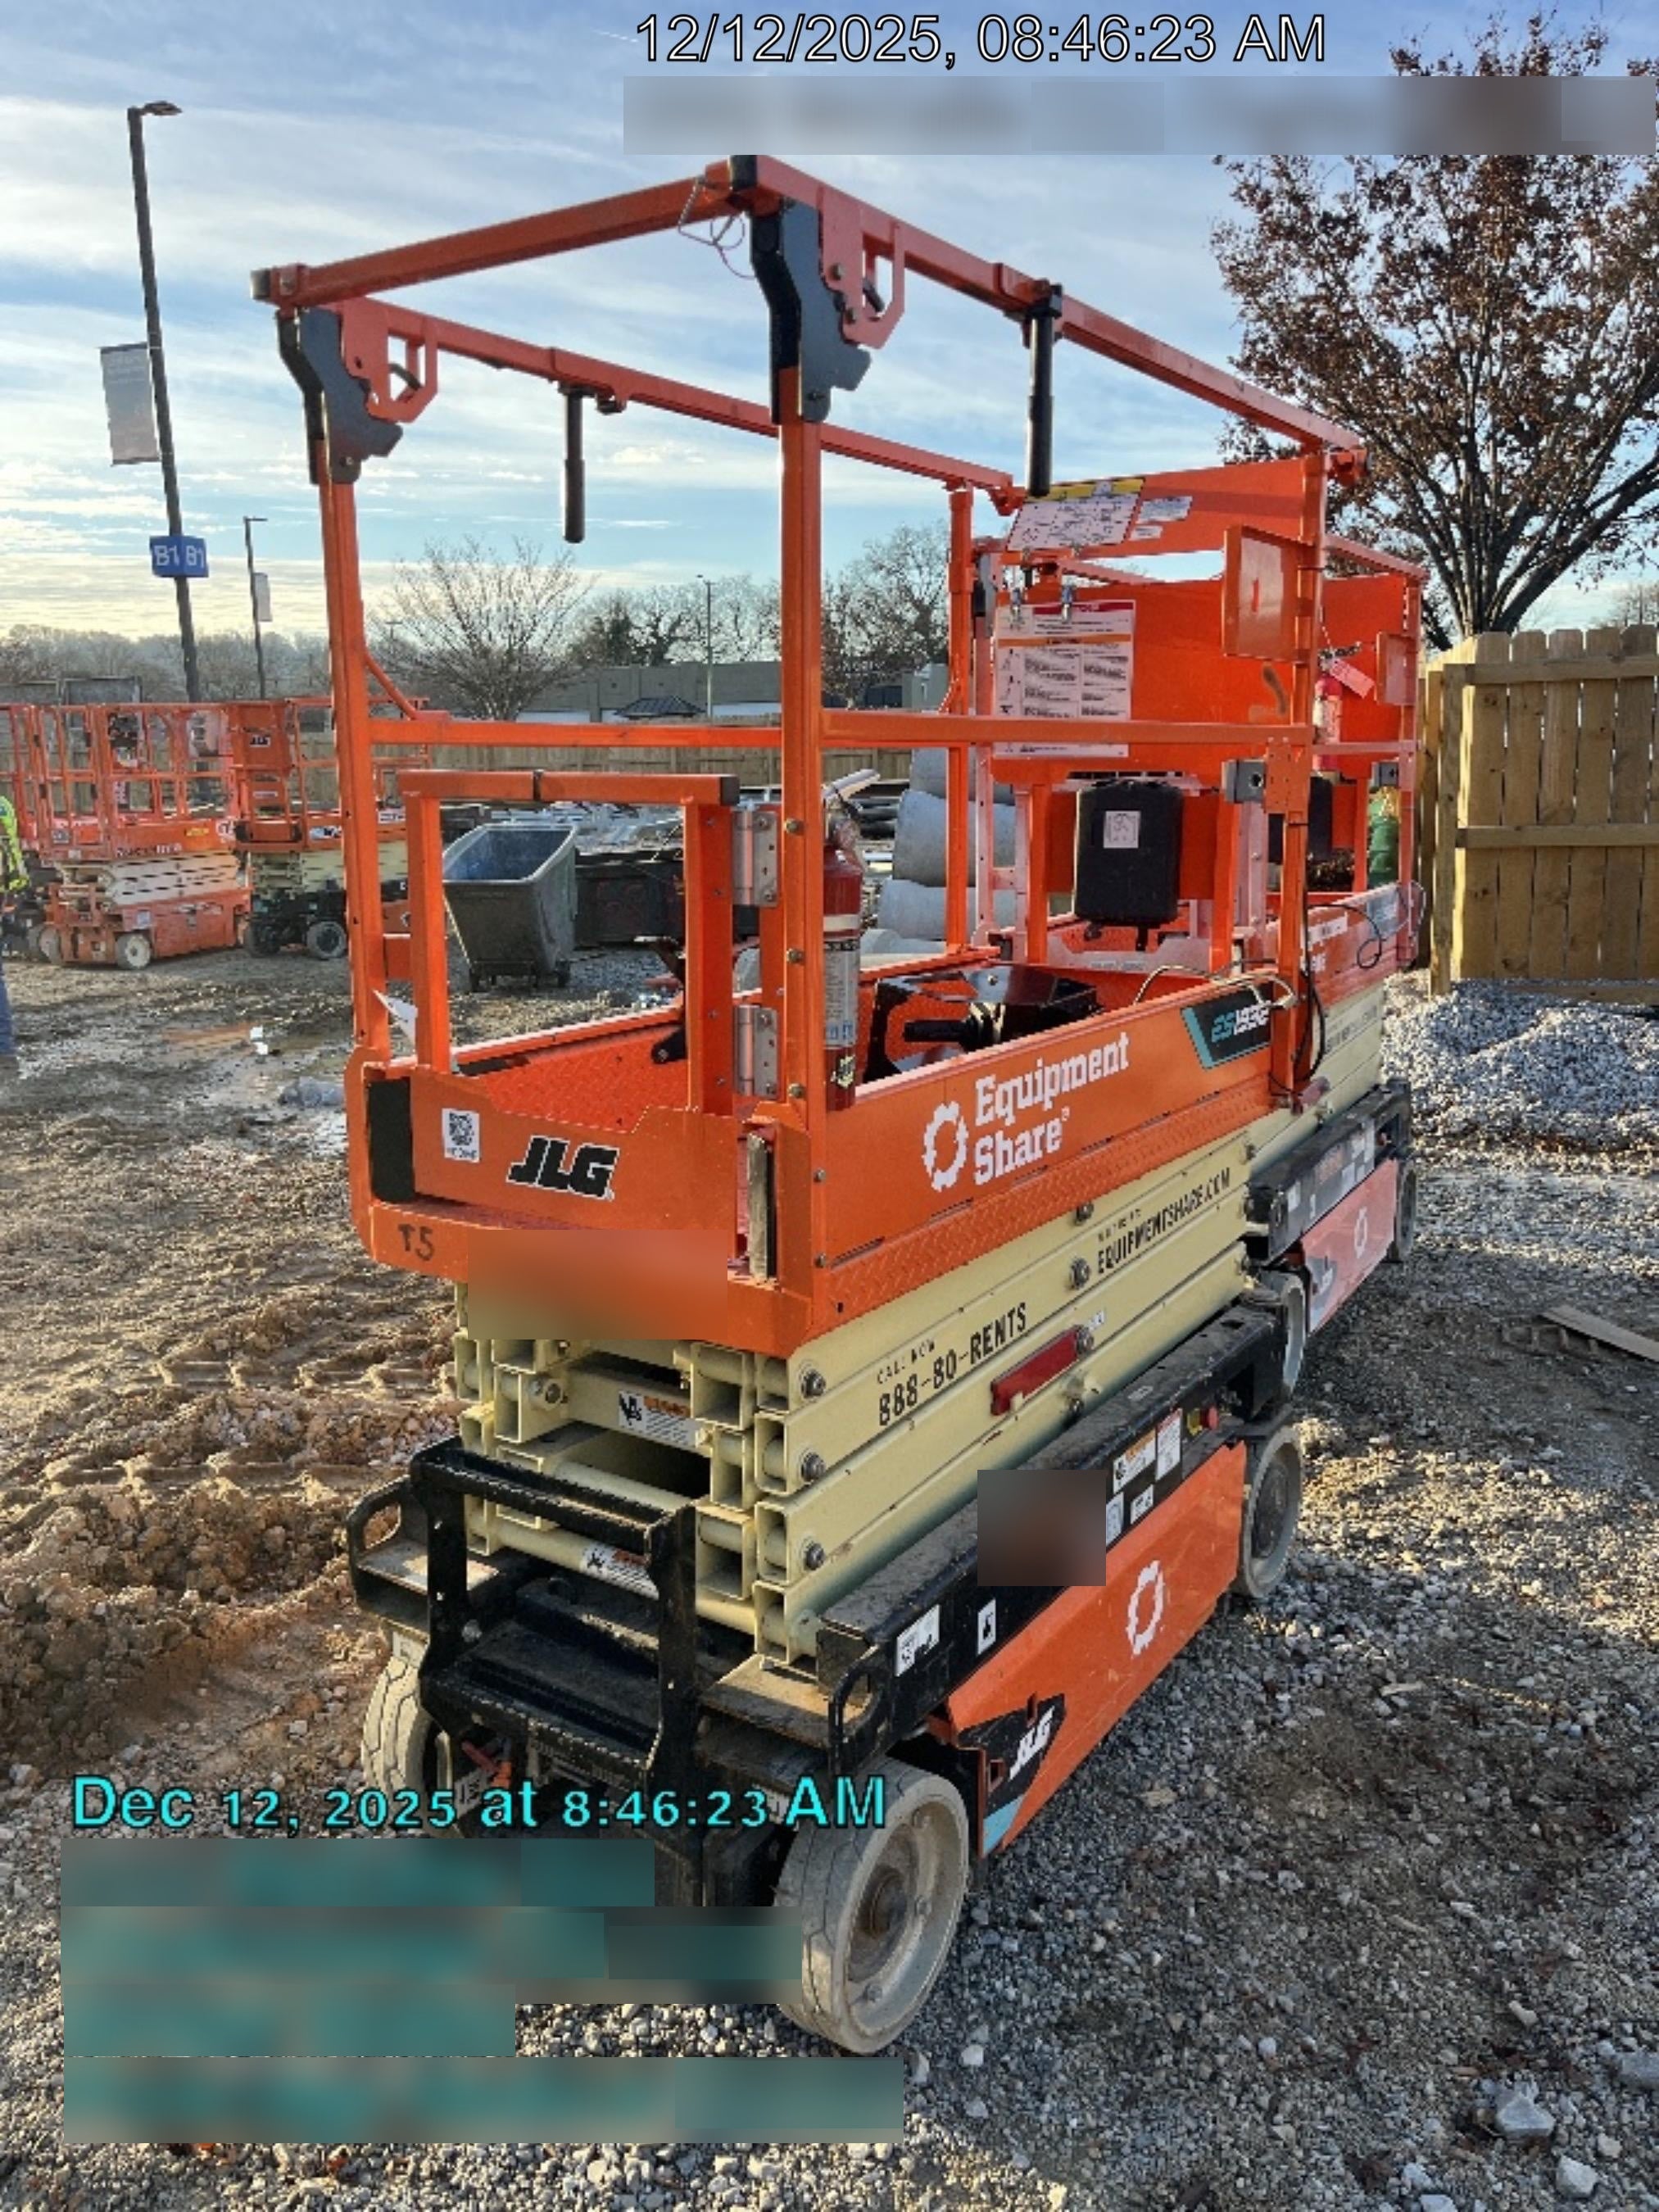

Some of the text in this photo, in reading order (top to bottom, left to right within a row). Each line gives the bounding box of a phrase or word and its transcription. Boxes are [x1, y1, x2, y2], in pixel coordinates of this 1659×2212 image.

[153, 545, 179, 565] B1
[975, 1031, 1130, 1126] Equipment
[505, 1135, 620, 1202] JLG
[398, 1223, 436, 1262] T5
[879, 1301, 1027, 1426] 888-80-RENTS
[1008, 1705, 1055, 1783] JLG
